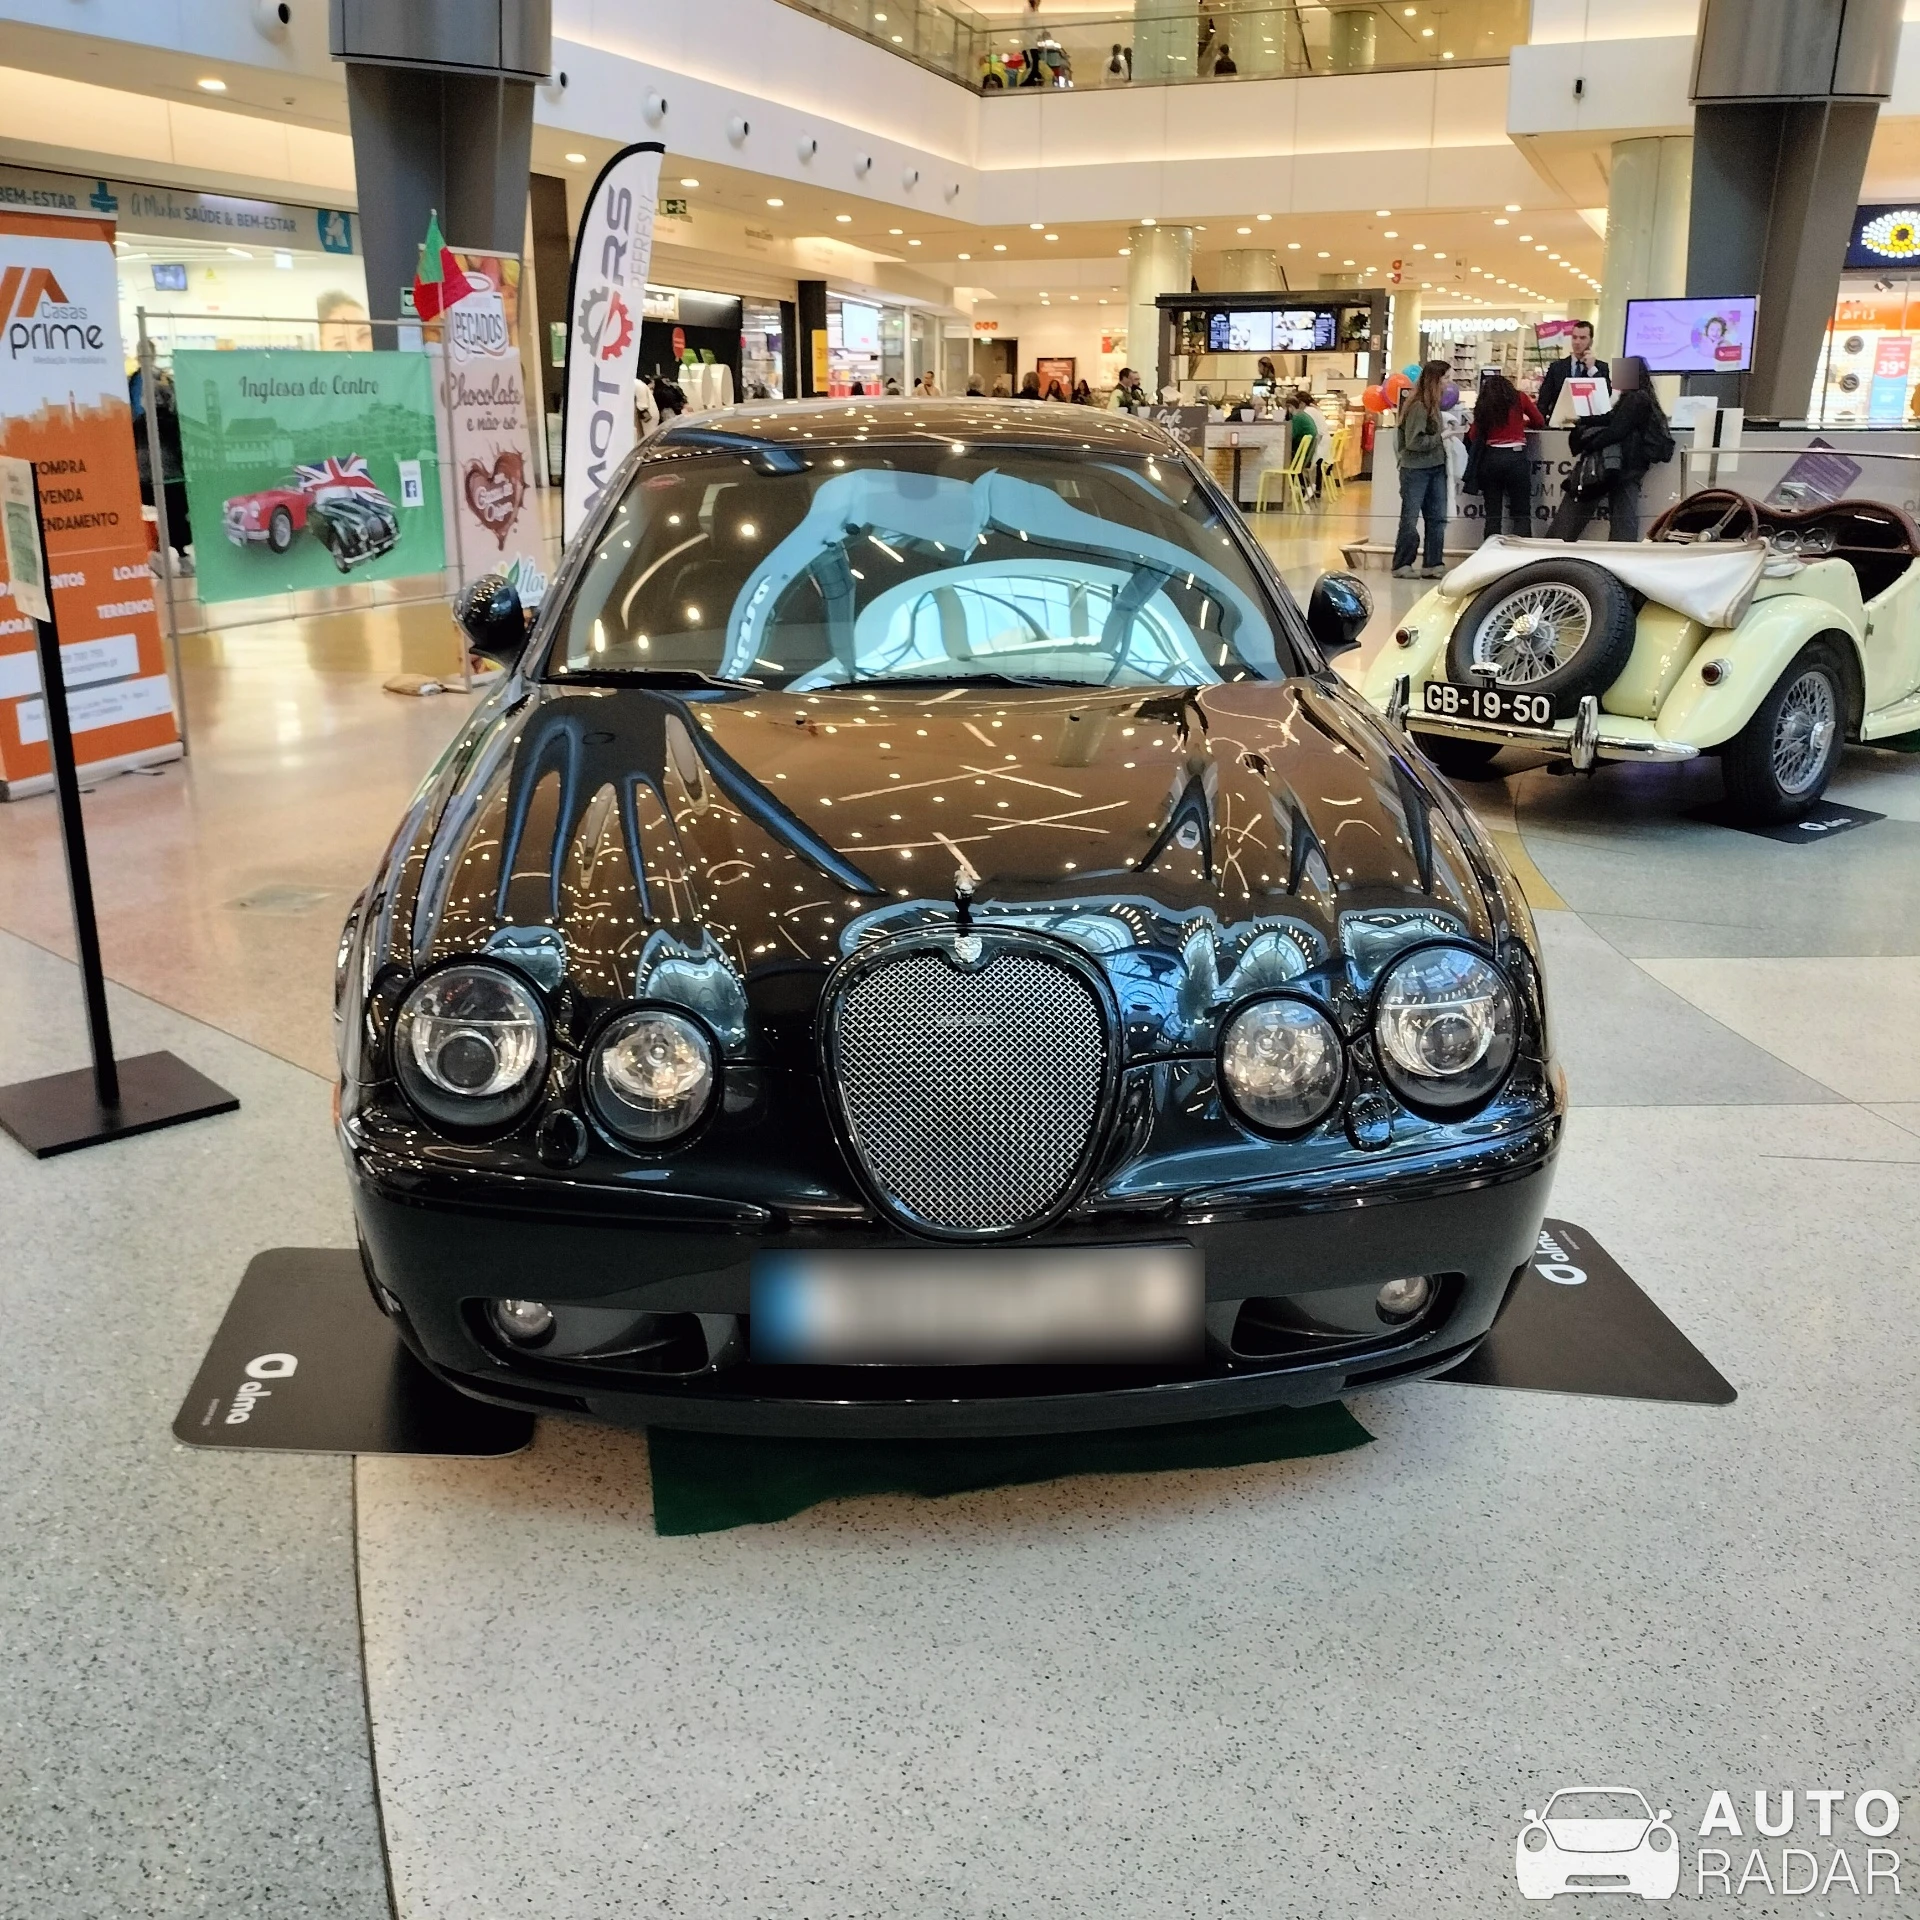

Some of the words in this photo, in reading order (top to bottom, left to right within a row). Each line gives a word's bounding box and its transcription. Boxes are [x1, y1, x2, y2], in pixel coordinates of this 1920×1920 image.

[185, 206, 221, 225] SAÚDE
[225, 212, 233, 226] &
[237, 212, 297, 233] BEM-ESTAR
[41, 301, 88, 319] Casas
[10, 322, 104, 361] prime
[454, 312, 503, 346] PECADOS
[239, 375, 305, 404] Ingleses
[333, 374, 379, 396] Centro
[40, 488, 84, 504] VENDA
[1426, 684, 1551, 724] GB-19-50
[224, 1381, 272, 1425] alma
